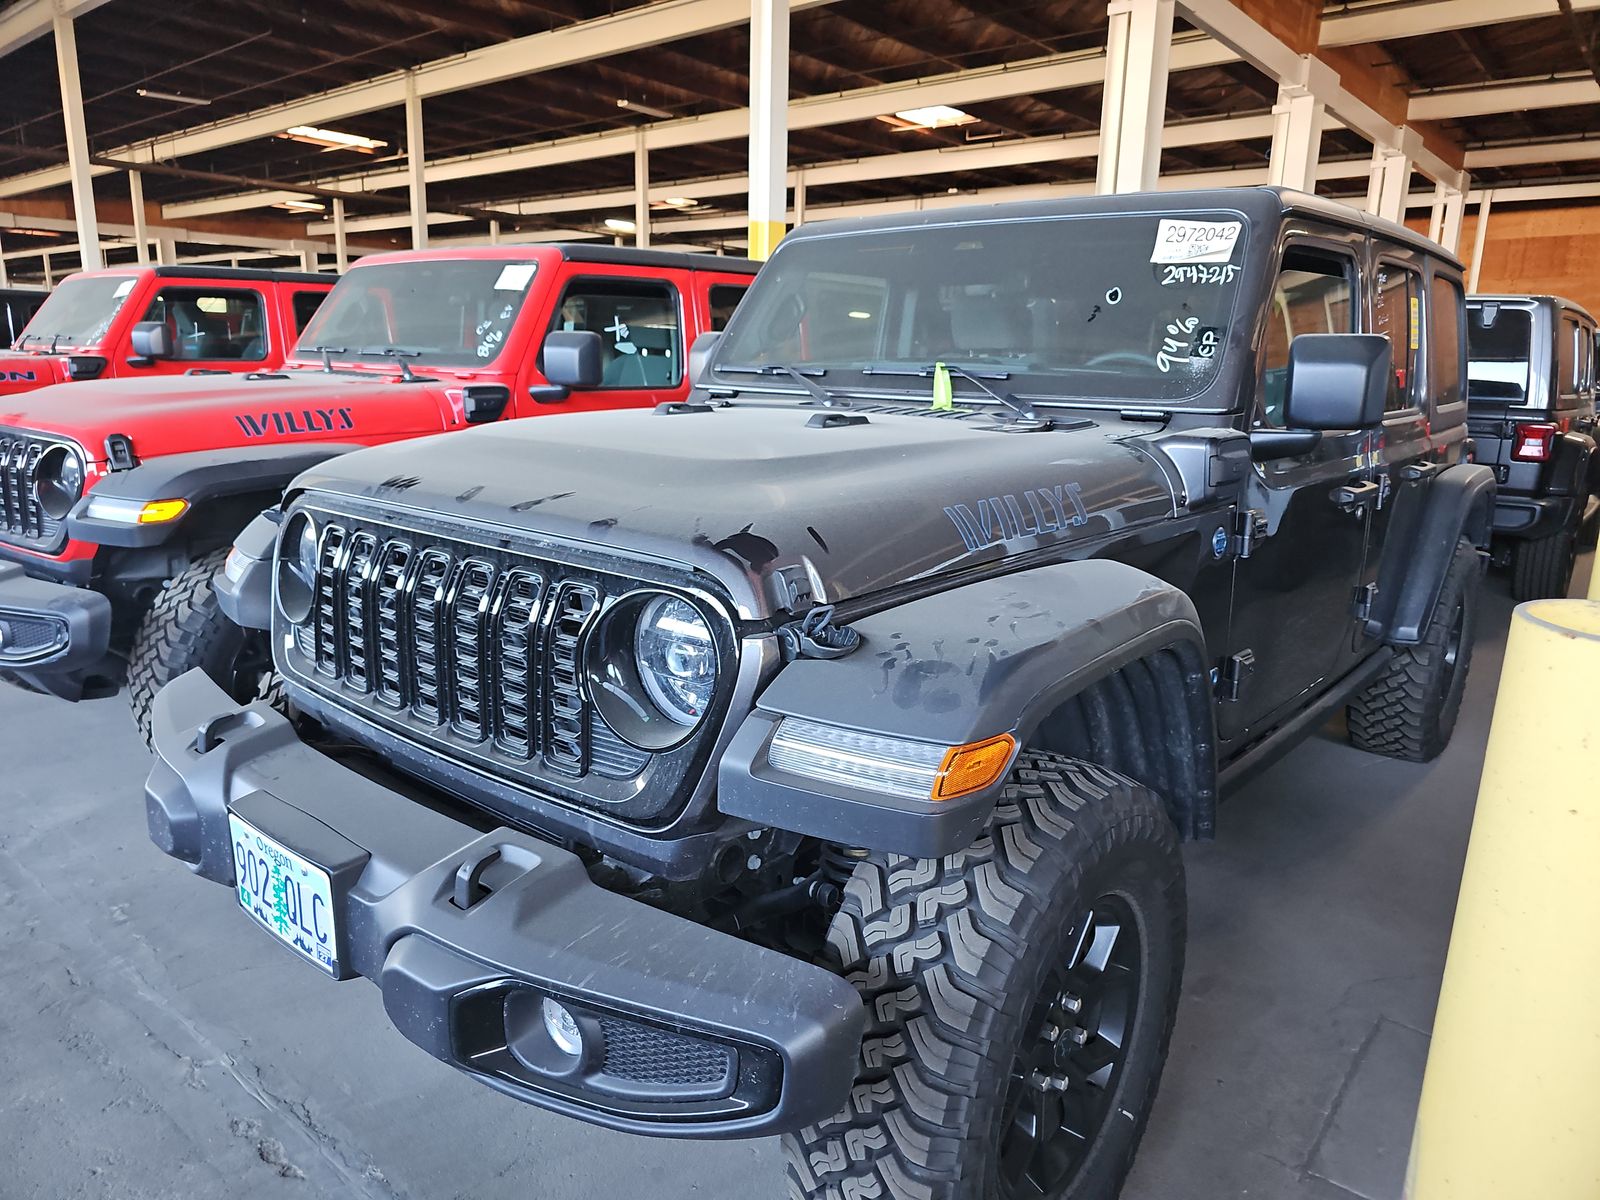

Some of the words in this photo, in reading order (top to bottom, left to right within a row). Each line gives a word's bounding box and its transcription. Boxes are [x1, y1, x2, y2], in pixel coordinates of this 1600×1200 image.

[1165, 225, 1237, 243] 2972042
[1156, 317, 1200, 373] 94%
[234, 407, 354, 438] WILLYS
[943, 482, 1089, 551] WILLYS
[256, 836, 294, 871] Oregon
[235, 841, 273, 909] 902
[284, 875, 328, 944] QLC
